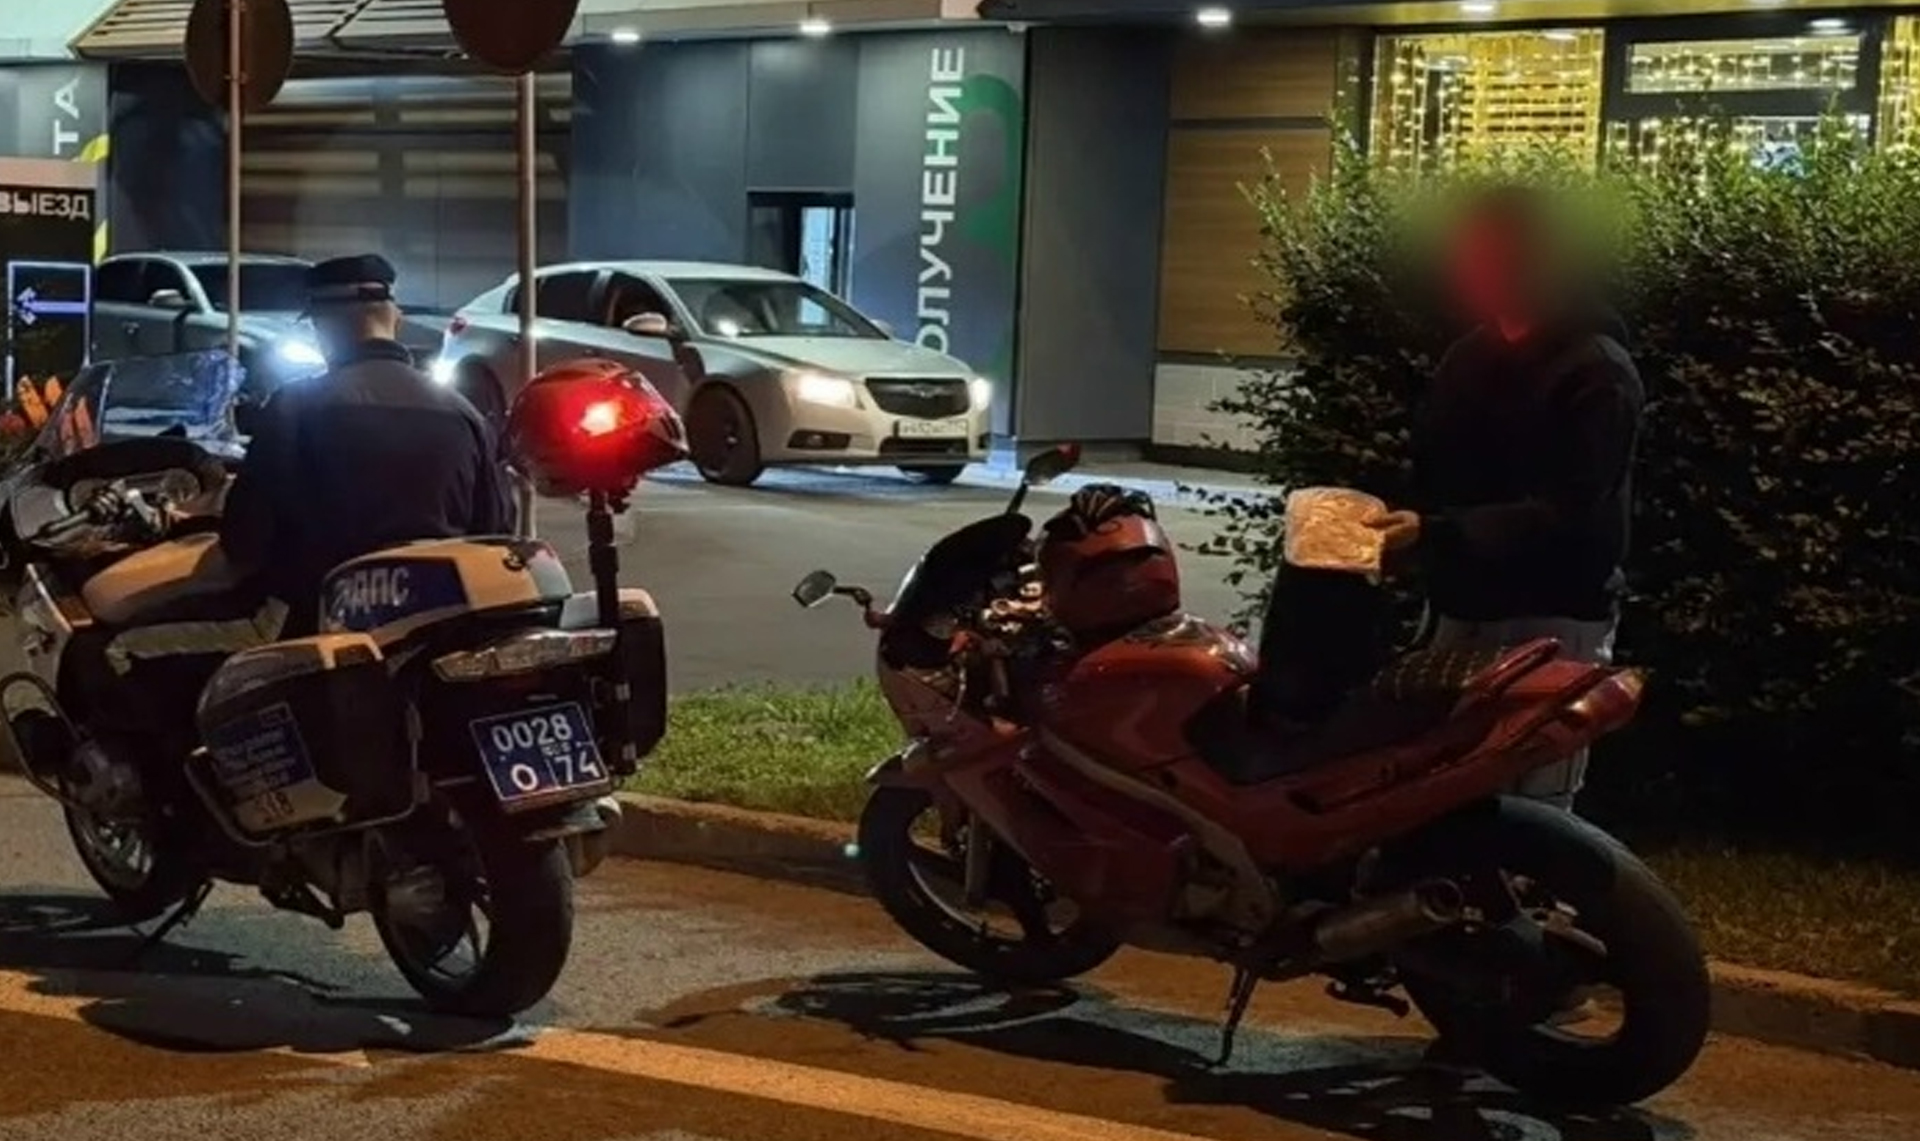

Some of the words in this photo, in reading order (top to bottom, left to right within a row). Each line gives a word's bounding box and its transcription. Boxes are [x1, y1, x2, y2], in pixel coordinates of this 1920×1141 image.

[53, 77, 80, 155] ТА
[0, 190, 90, 220] ВЫЕЗД
[915, 47, 964, 353] ОЛУЧЕНИЕ
[350, 567, 410, 615] ДПС
[491, 713, 573, 752] 0028
[554, 750, 600, 783] 74
